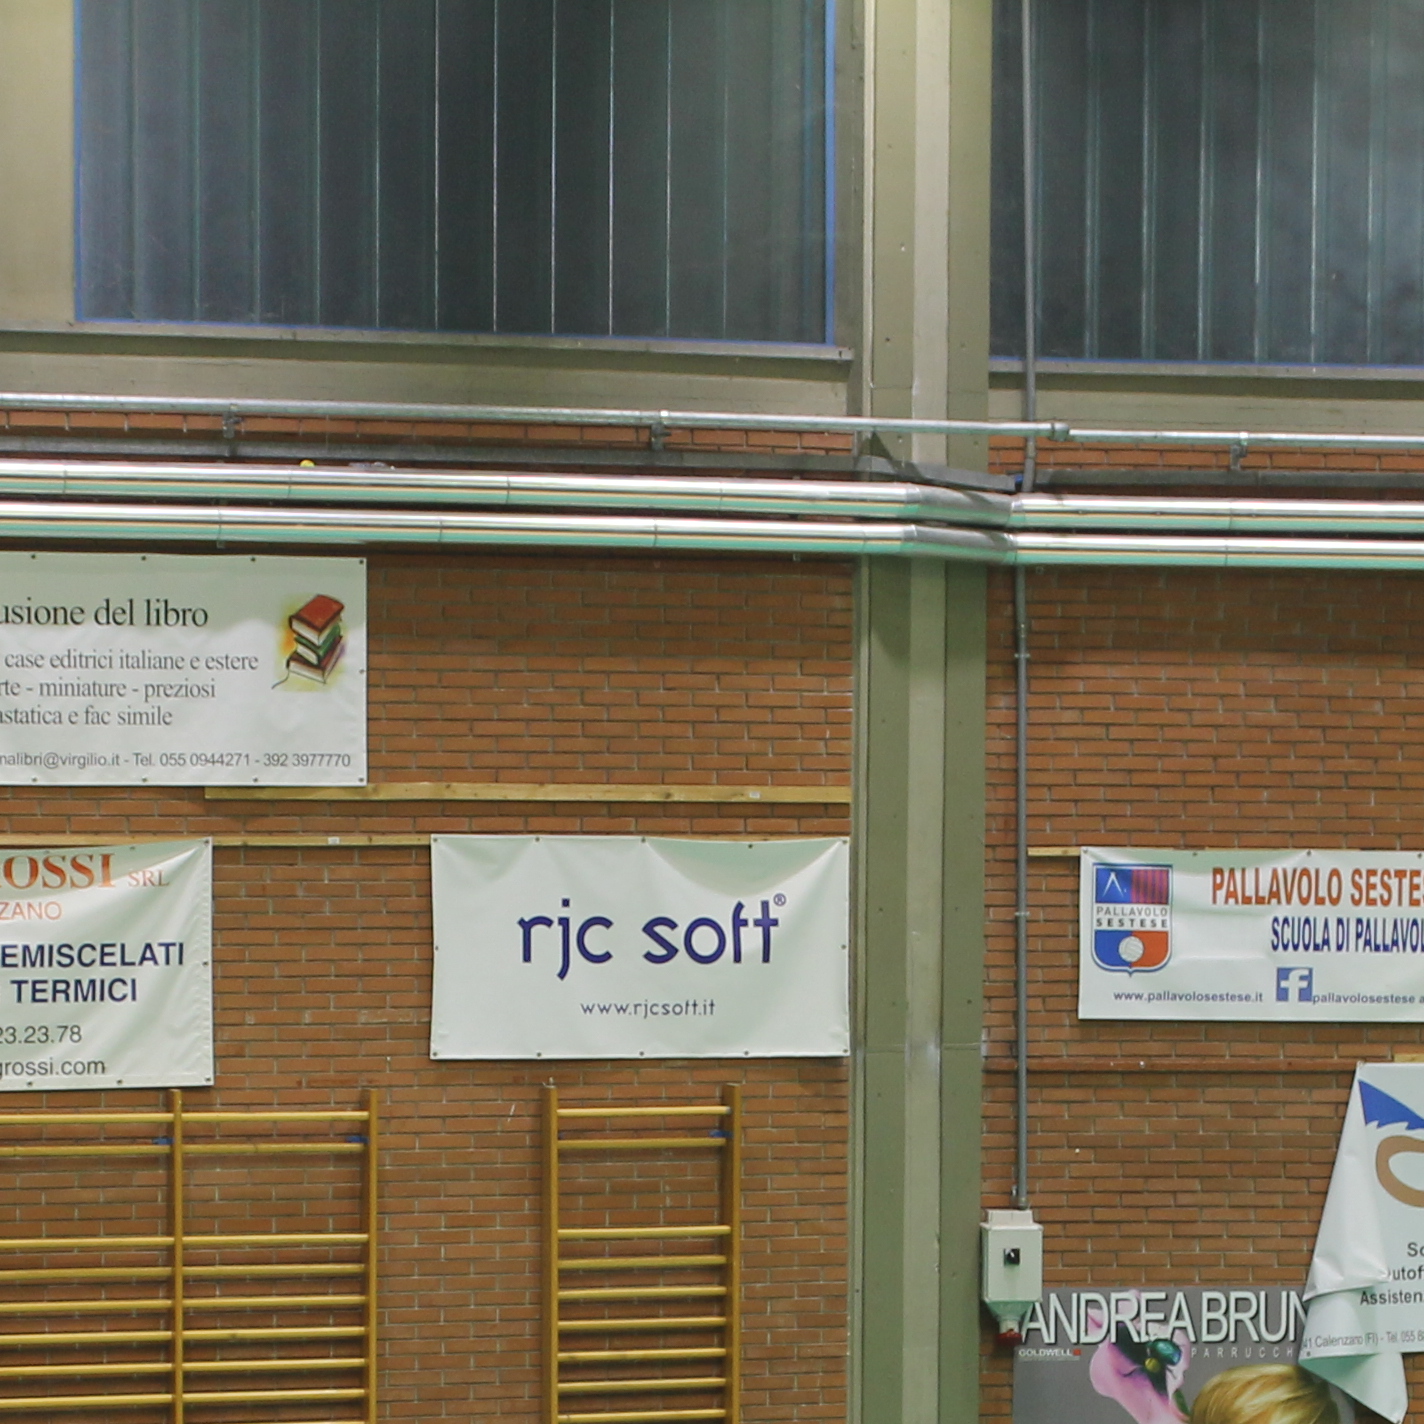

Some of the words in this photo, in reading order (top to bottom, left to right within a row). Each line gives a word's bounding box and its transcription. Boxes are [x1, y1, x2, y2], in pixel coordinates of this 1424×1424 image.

[94, 598, 134, 627] del
[144, 598, 208, 627] libro
[4, 653, 44, 669] case
[49, 649, 114, 670] editrici
[119, 649, 186, 670] italiane
[204, 653, 259, 671] estere
[38, 677, 127, 698] miniature
[144, 678, 216, 702] preziosi
[84, 706, 111, 725] fac
[117, 706, 173, 726] simile
[134, 752, 156, 767] Tel.
[159, 752, 187, 767] 055
[263, 752, 288, 768] 392
[292, 753, 351, 768] 3977770
[127, 868, 170, 888] SRL
[1211, 867, 1343, 907] PALLAVOLO
[1096, 906, 1168, 917] PALLAVOLO
[1096, 918, 1168, 928] SESTESE
[517, 898, 614, 981] rjc
[1270, 917, 1331, 952] SCUOLA
[1335, 917, 1350, 952] DI
[11, 977, 137, 1004] TERMICI
[1113, 989, 1263, 1005] www.pallavolosestese.it
[1312, 991, 1415, 1006] pallavolosestese
[580, 999, 716, 1019] www.rjcsoft.it
[1022, 1291, 1196, 1345] ANDREA
[1315, 1334, 1363, 1348] Calenzano
[1018, 1347, 1073, 1357] GOLDWELL
